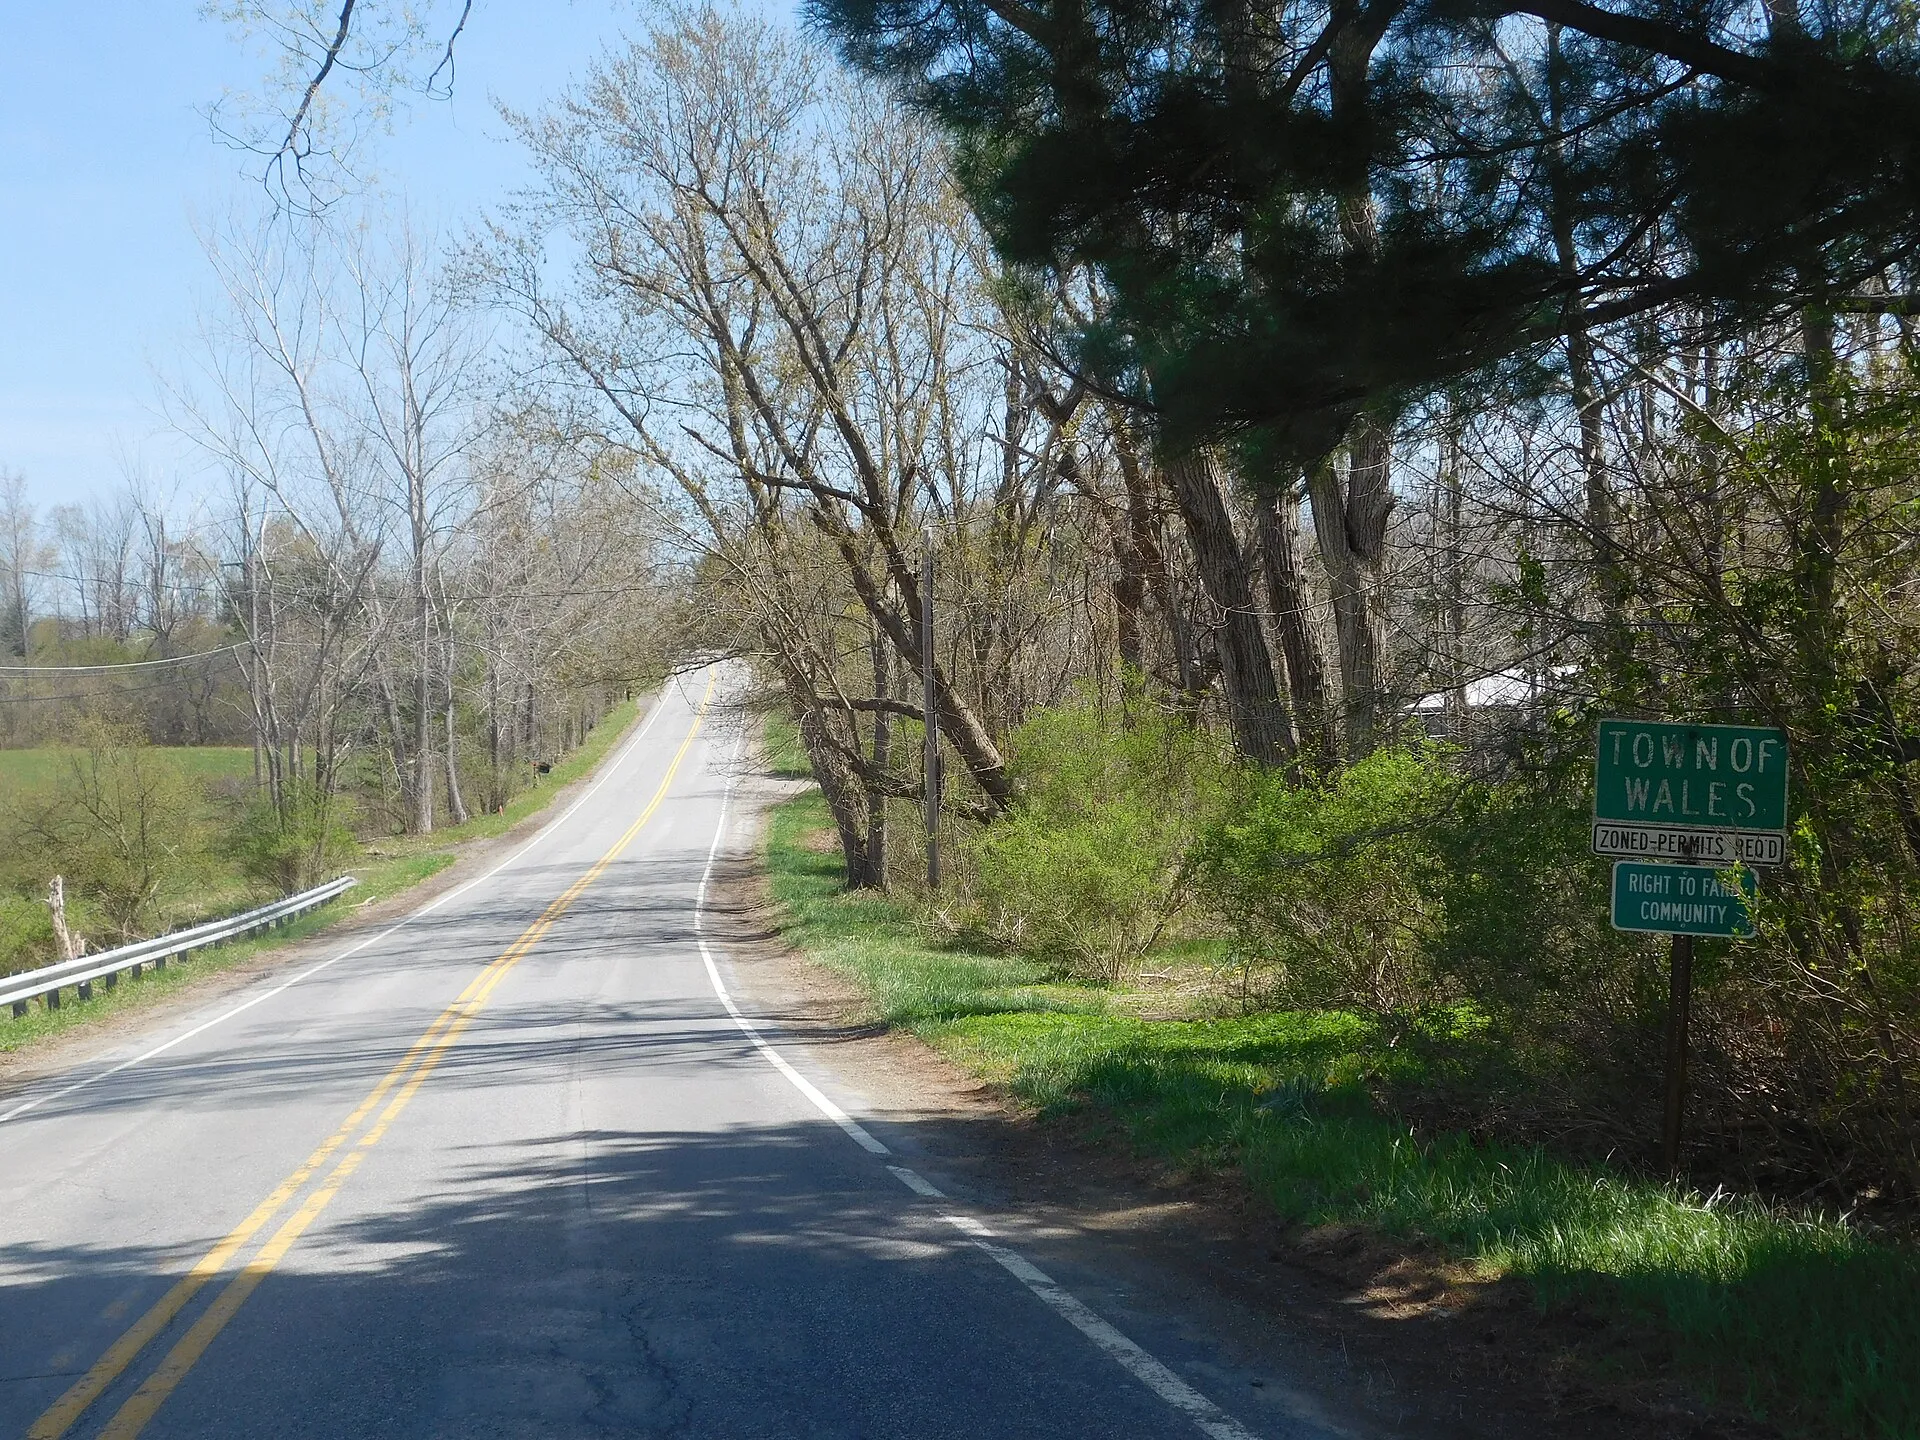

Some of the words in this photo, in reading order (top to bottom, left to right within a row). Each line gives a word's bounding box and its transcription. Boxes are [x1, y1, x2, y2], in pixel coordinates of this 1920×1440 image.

[1609, 731, 1718, 771] TOWN
[1730, 738, 1778, 773] OF
[1624, 776, 1756, 817] WALES
[1600, 829, 1725, 855] ZONED-PERMITS
[1628, 873, 1672, 895] RIGHT
[1678, 876, 1696, 896] TO
[1640, 901, 1728, 925] COMMUNITY
